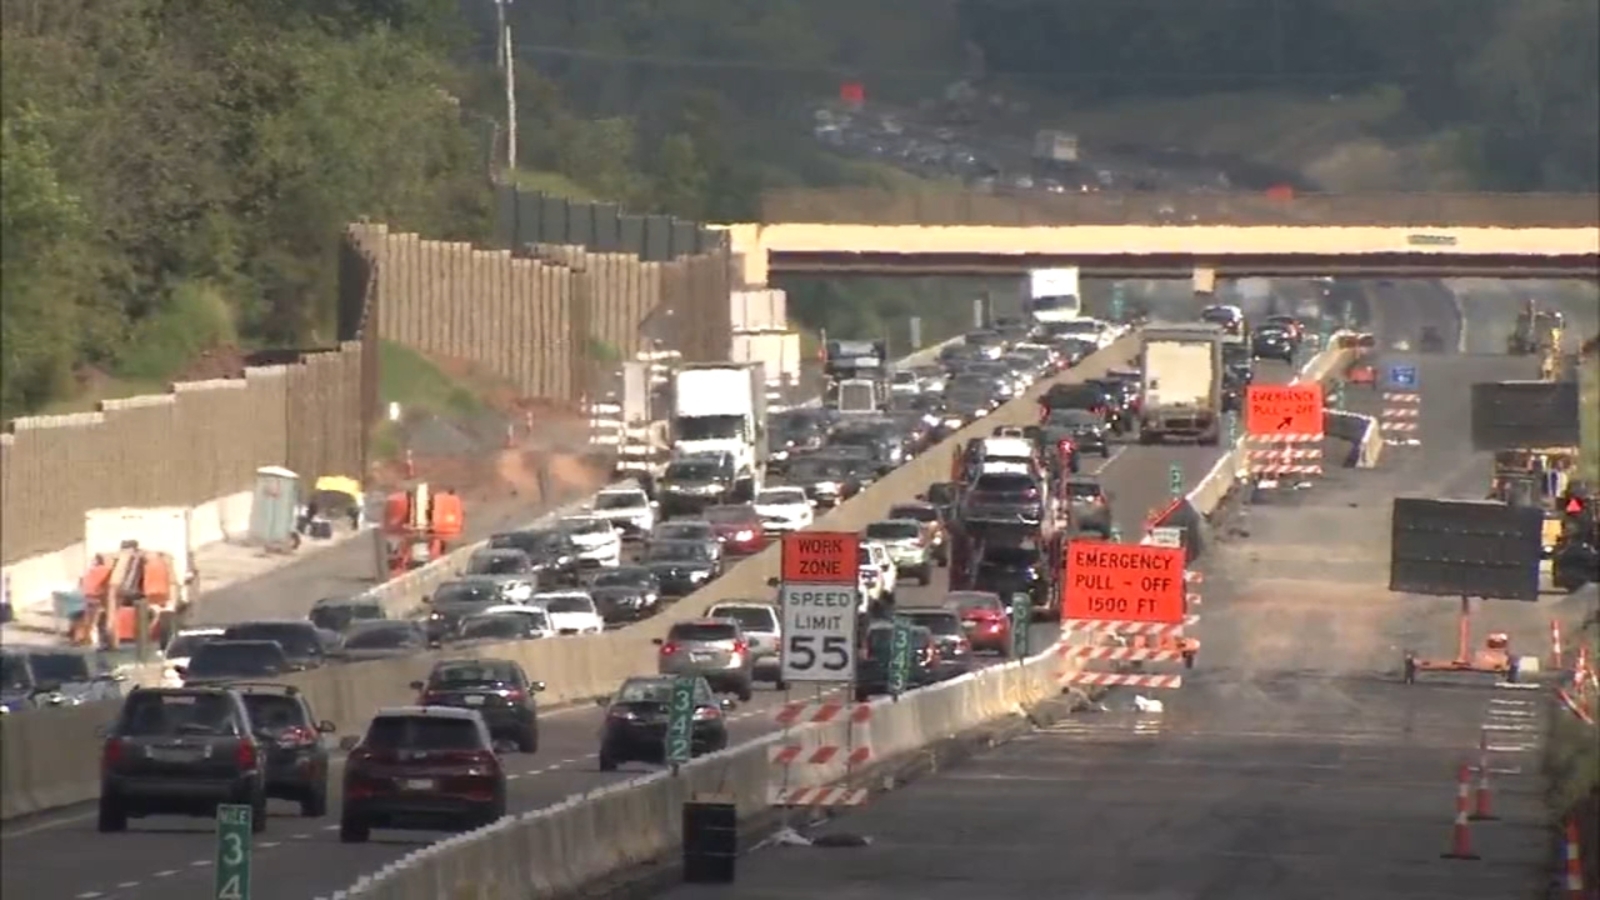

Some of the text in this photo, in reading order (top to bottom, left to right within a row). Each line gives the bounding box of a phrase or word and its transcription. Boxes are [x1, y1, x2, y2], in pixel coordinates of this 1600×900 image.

[798, 539, 842, 553] WORK
[799, 560, 841, 575] ZONE
[1075, 551, 1174, 571] EMERGENCY
[1075, 574, 1115, 591] PULL
[1140, 576, 1173, 592] OFF
[789, 591, 850, 607] SPEED
[1087, 595, 1157, 615] 1500 FT
[794, 614, 842, 630] LIMIT
[788, 635, 850, 671] 55
[671, 689, 691, 761] 342
